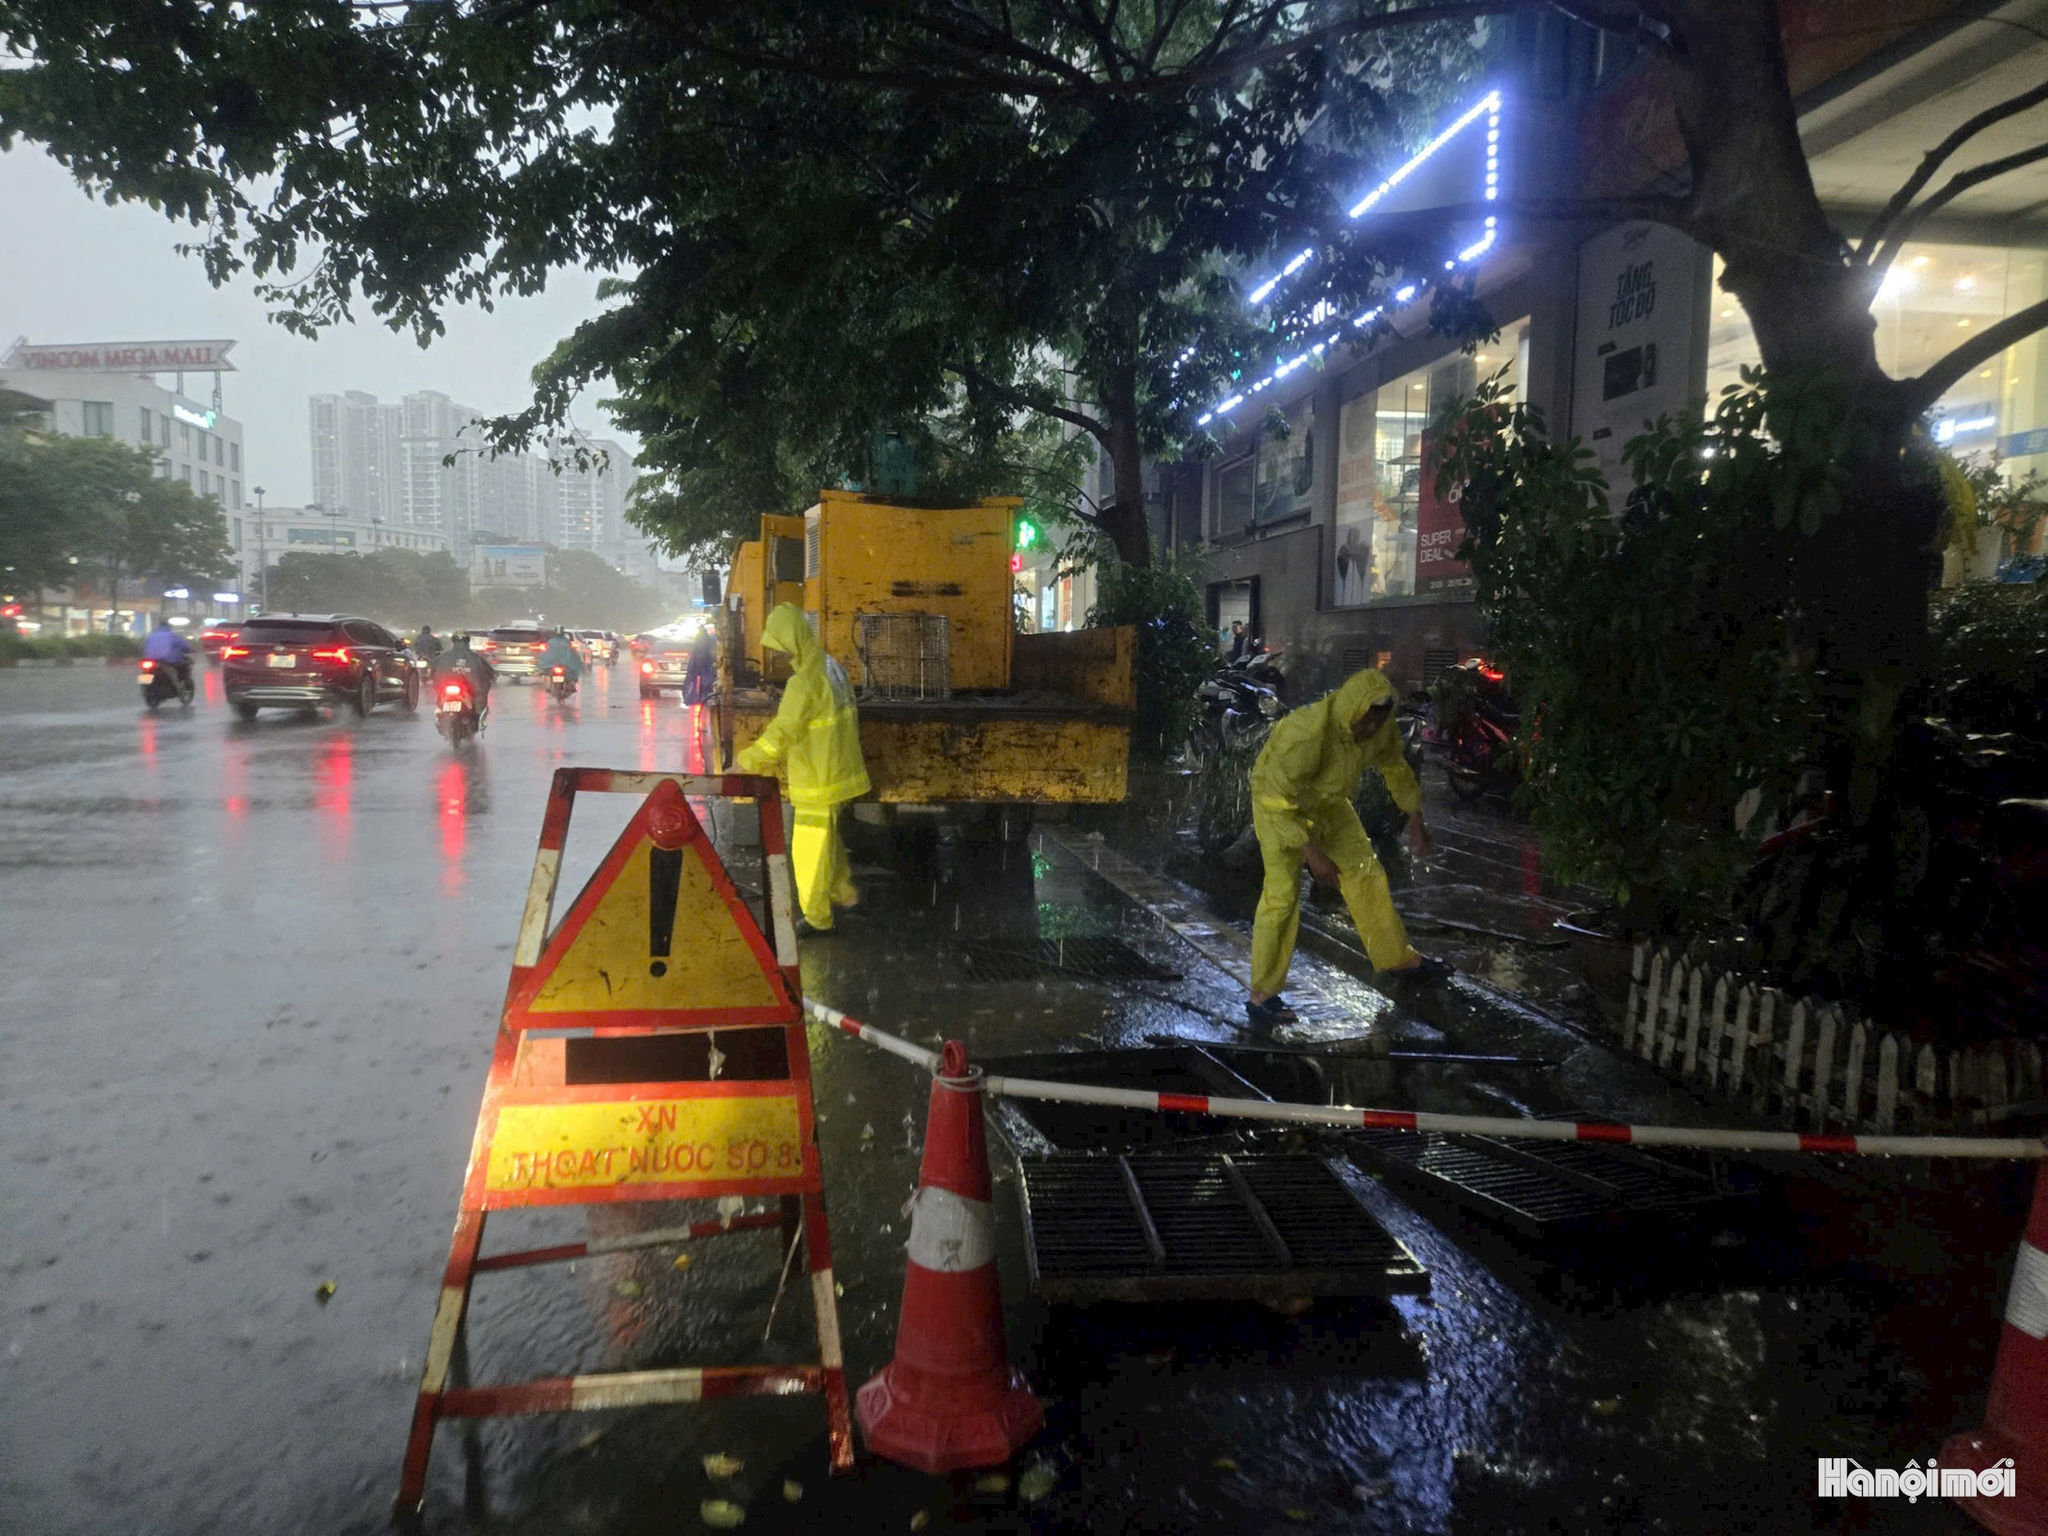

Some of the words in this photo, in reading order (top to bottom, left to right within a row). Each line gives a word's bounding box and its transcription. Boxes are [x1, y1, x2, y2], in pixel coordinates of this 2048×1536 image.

[23, 351, 99, 368] VINCOM
[104, 348, 158, 366] MEGA
[164, 346, 216, 364] MALL
[1420, 530, 1451, 547] SUPER
[1420, 548, 1444, 563] DEAL
[635, 1104, 677, 1132] XN
